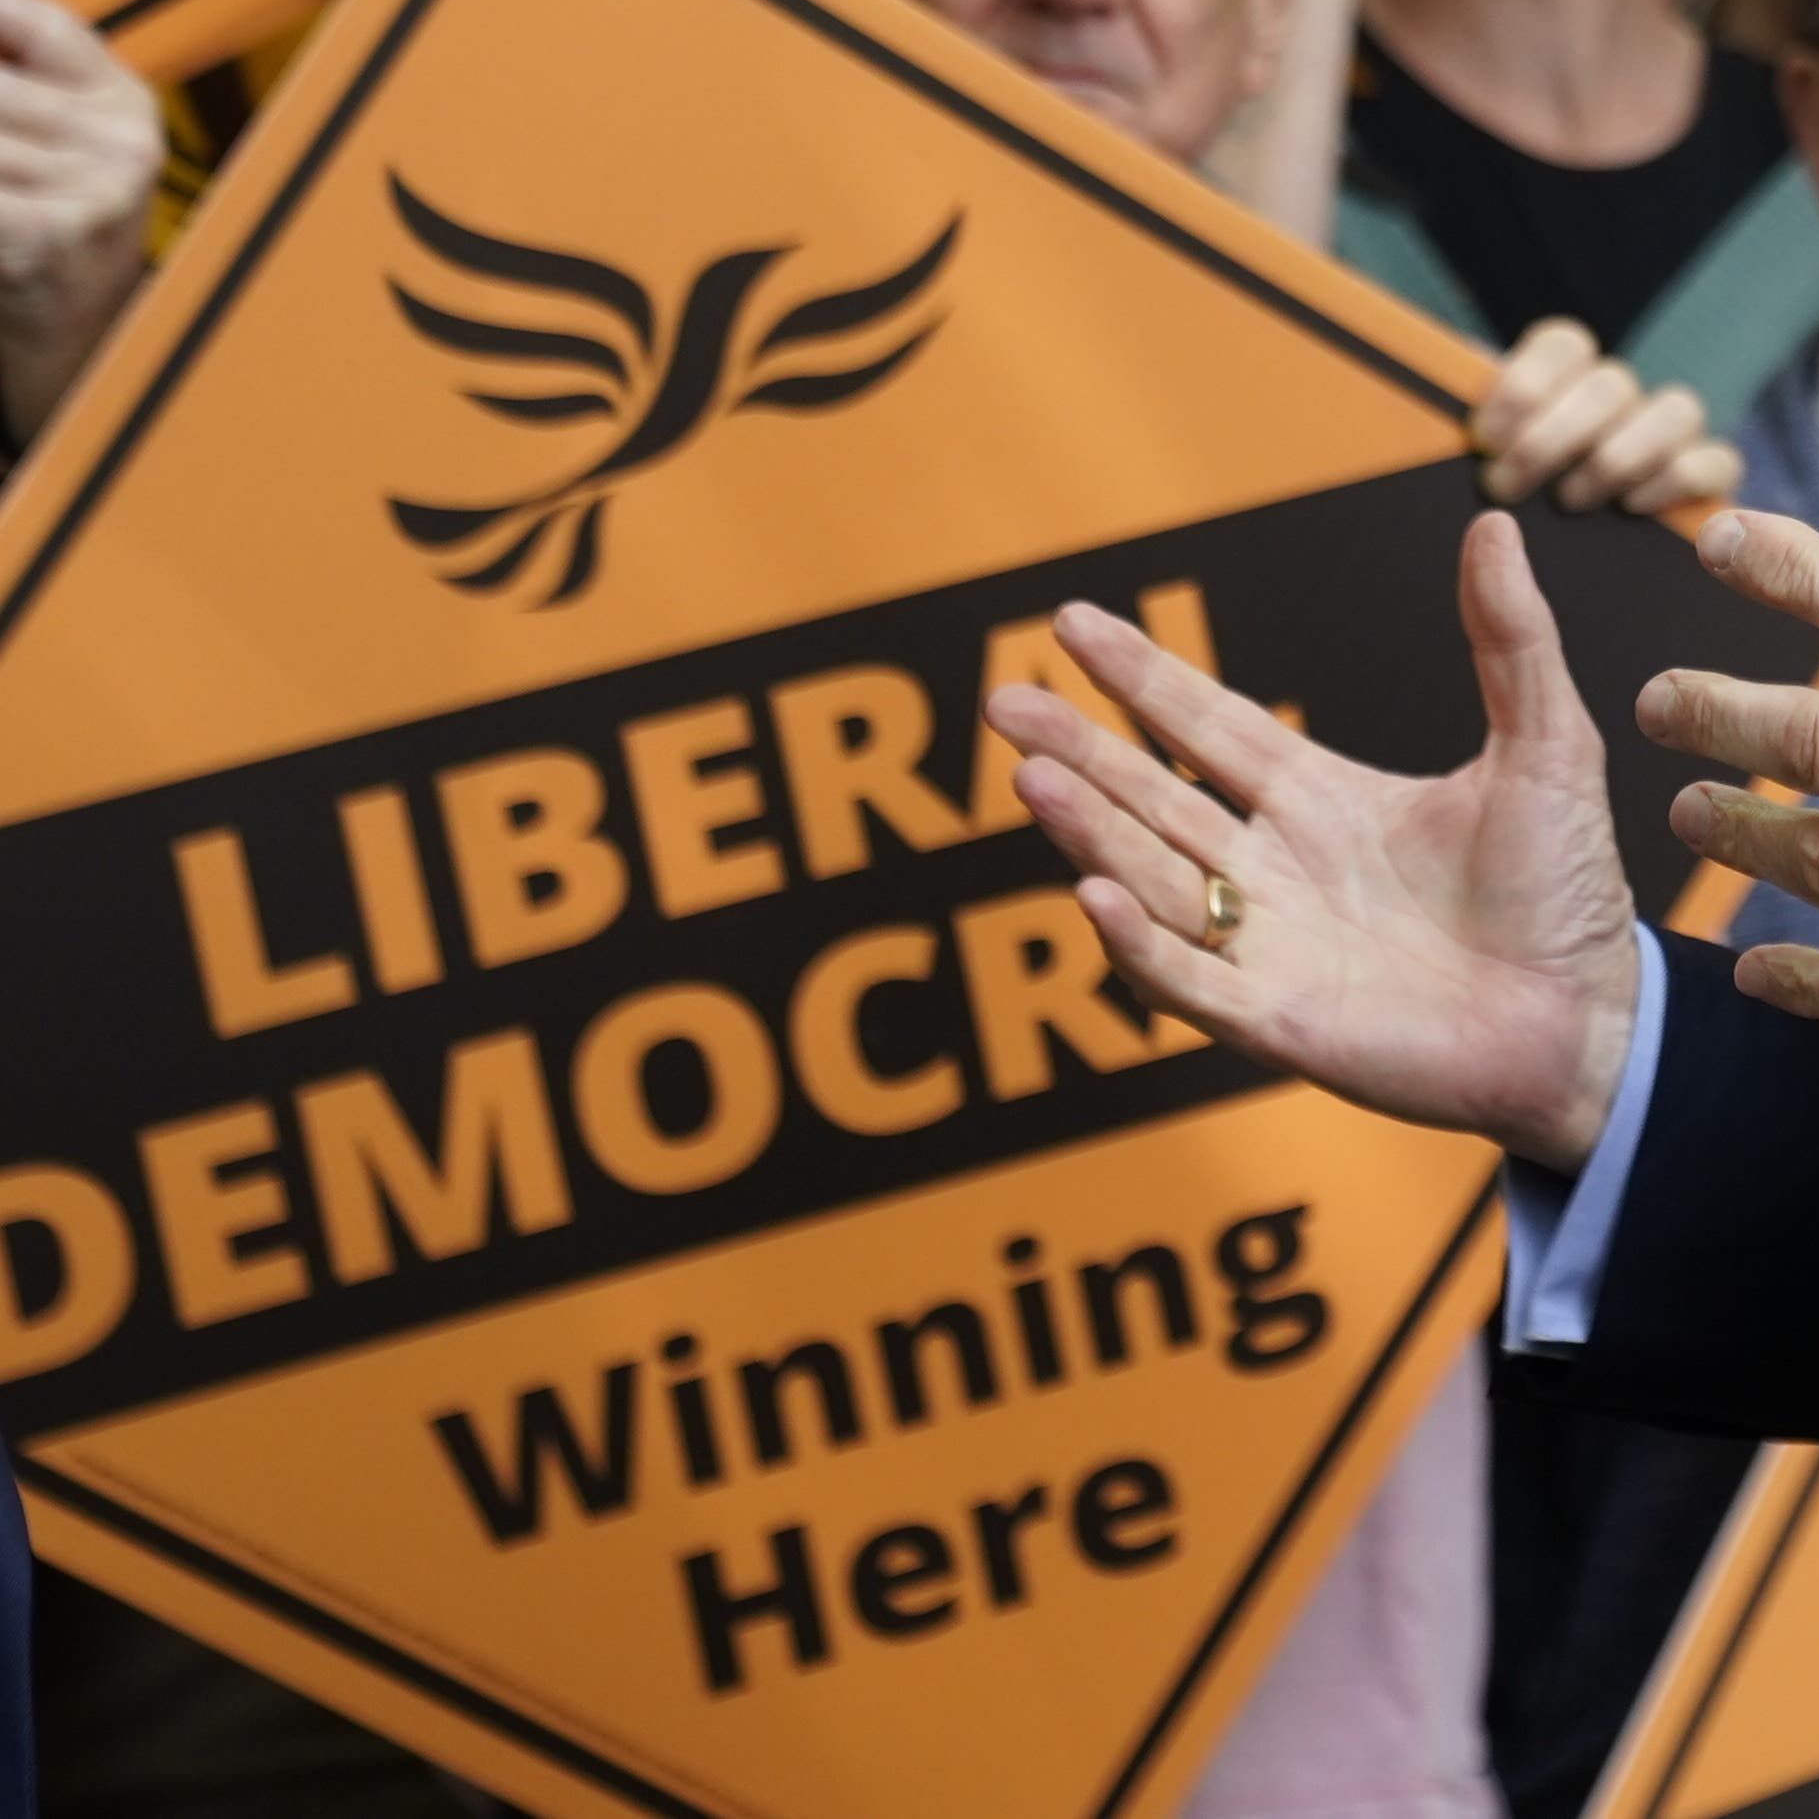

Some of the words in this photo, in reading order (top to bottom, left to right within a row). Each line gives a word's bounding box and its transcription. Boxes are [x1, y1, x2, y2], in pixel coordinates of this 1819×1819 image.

[0, 882, 1215, 1386] DEMOCR
[428, 1199, 1337, 1555] Winning
[677, 1449, 1184, 1703] Here
